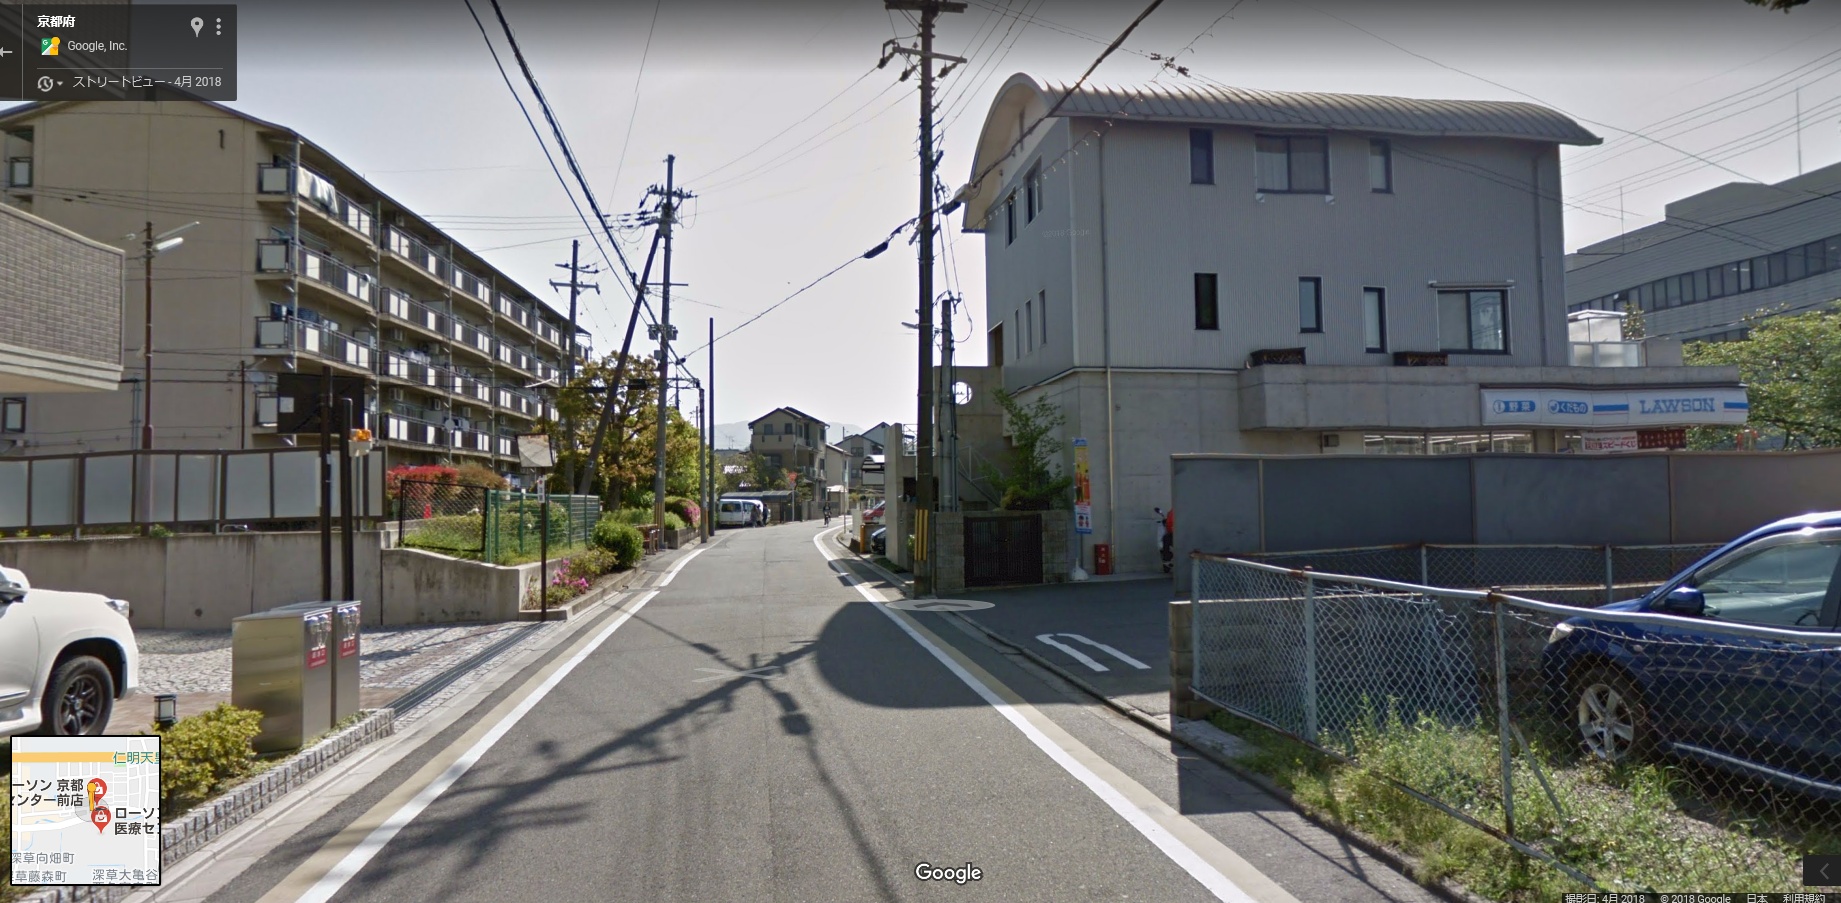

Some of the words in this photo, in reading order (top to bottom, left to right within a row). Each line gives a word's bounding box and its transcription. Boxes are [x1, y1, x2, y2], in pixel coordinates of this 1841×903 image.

[218, 129, 225, 149] 1
[1560, 402, 1586, 413] くだもの
[1639, 398, 1715, 414] LAWSON
